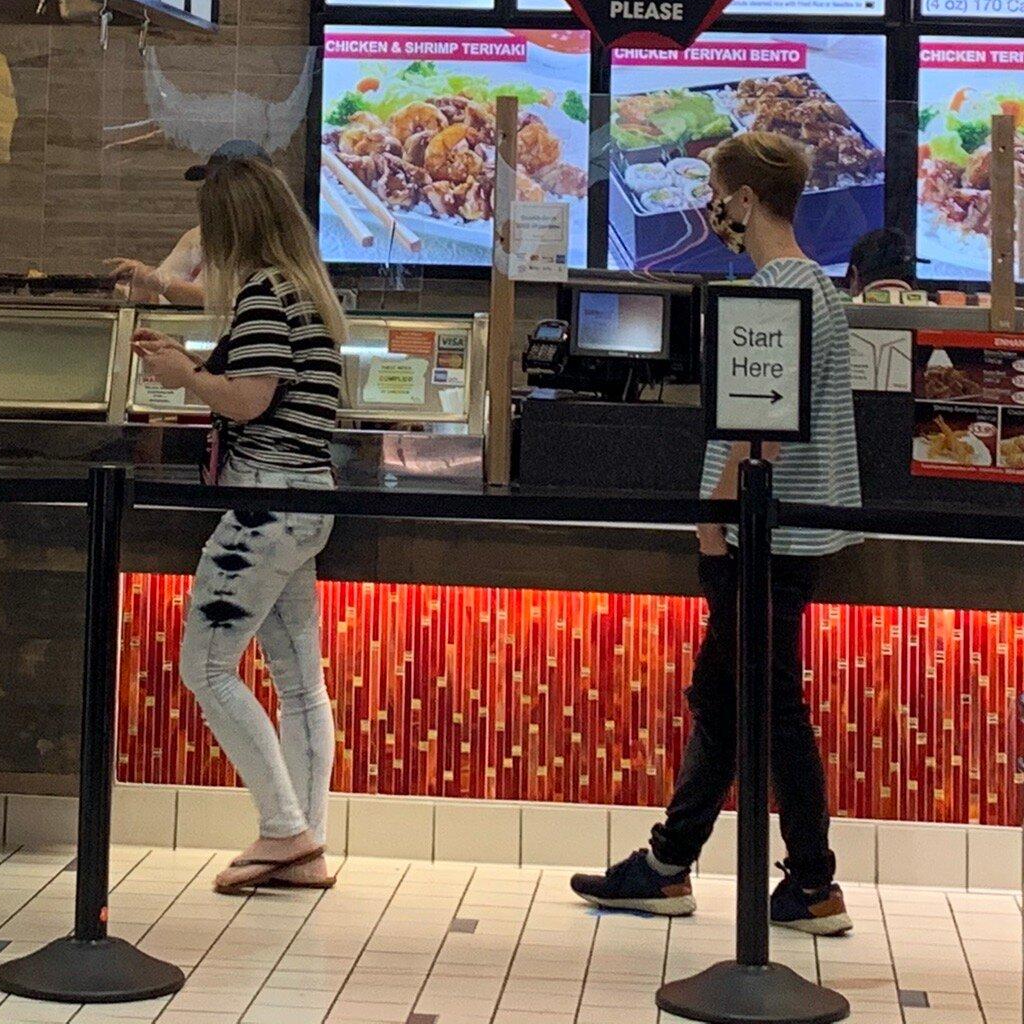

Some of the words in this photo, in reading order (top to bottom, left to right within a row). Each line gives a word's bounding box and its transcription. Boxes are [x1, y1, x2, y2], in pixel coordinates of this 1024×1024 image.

[610, 0, 683, 21] PLEASE
[326, 40, 388, 53] CHICKEN
[392, 41, 401, 53] &
[405, 41, 458, 54] SHRIMP
[462, 42, 525, 56] TERIYAKI
[615, 49, 677, 59] CHICKEN
[683, 49, 746, 61] TERIYAKI
[750, 50, 800, 62] BENTO
[920, 50, 986, 63] CHICKEN
[442, 338, 463, 346] VISA
[733, 326, 783, 348] Start
[732, 357, 784, 378] Here
